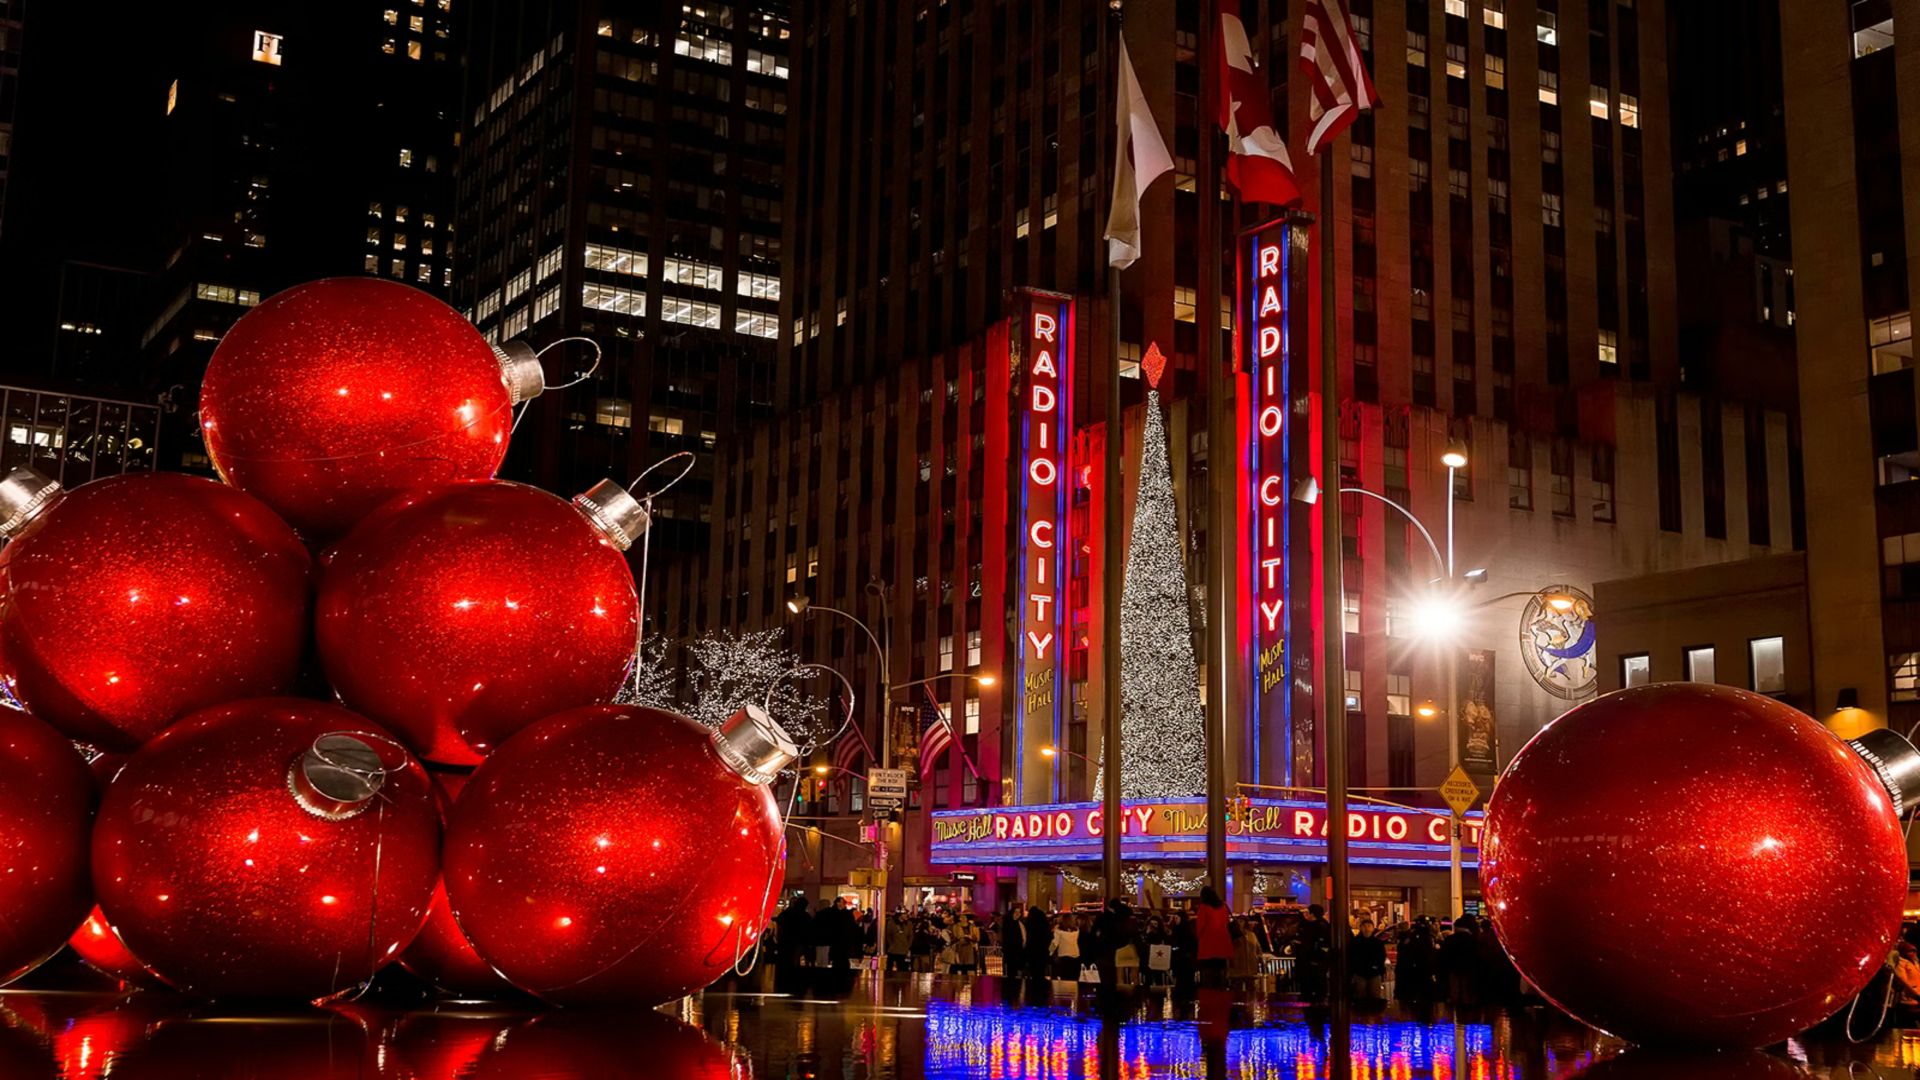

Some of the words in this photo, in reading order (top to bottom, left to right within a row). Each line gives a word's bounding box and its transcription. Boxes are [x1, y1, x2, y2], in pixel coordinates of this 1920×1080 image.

[1029, 312, 1057, 486] RADIO
[1260, 245, 1282, 437] RADIO
[1027, 520, 1053, 660] CITY
[1260, 475, 1283, 632] CITY
[935, 820, 967, 842] Music
[965, 814, 994, 843] Hall
[995, 812, 1072, 839] RADIO
[1087, 807, 1153, 835] CTY
[1163, 808, 1208, 834] Mus
[1294, 810, 1408, 841] RDIO
